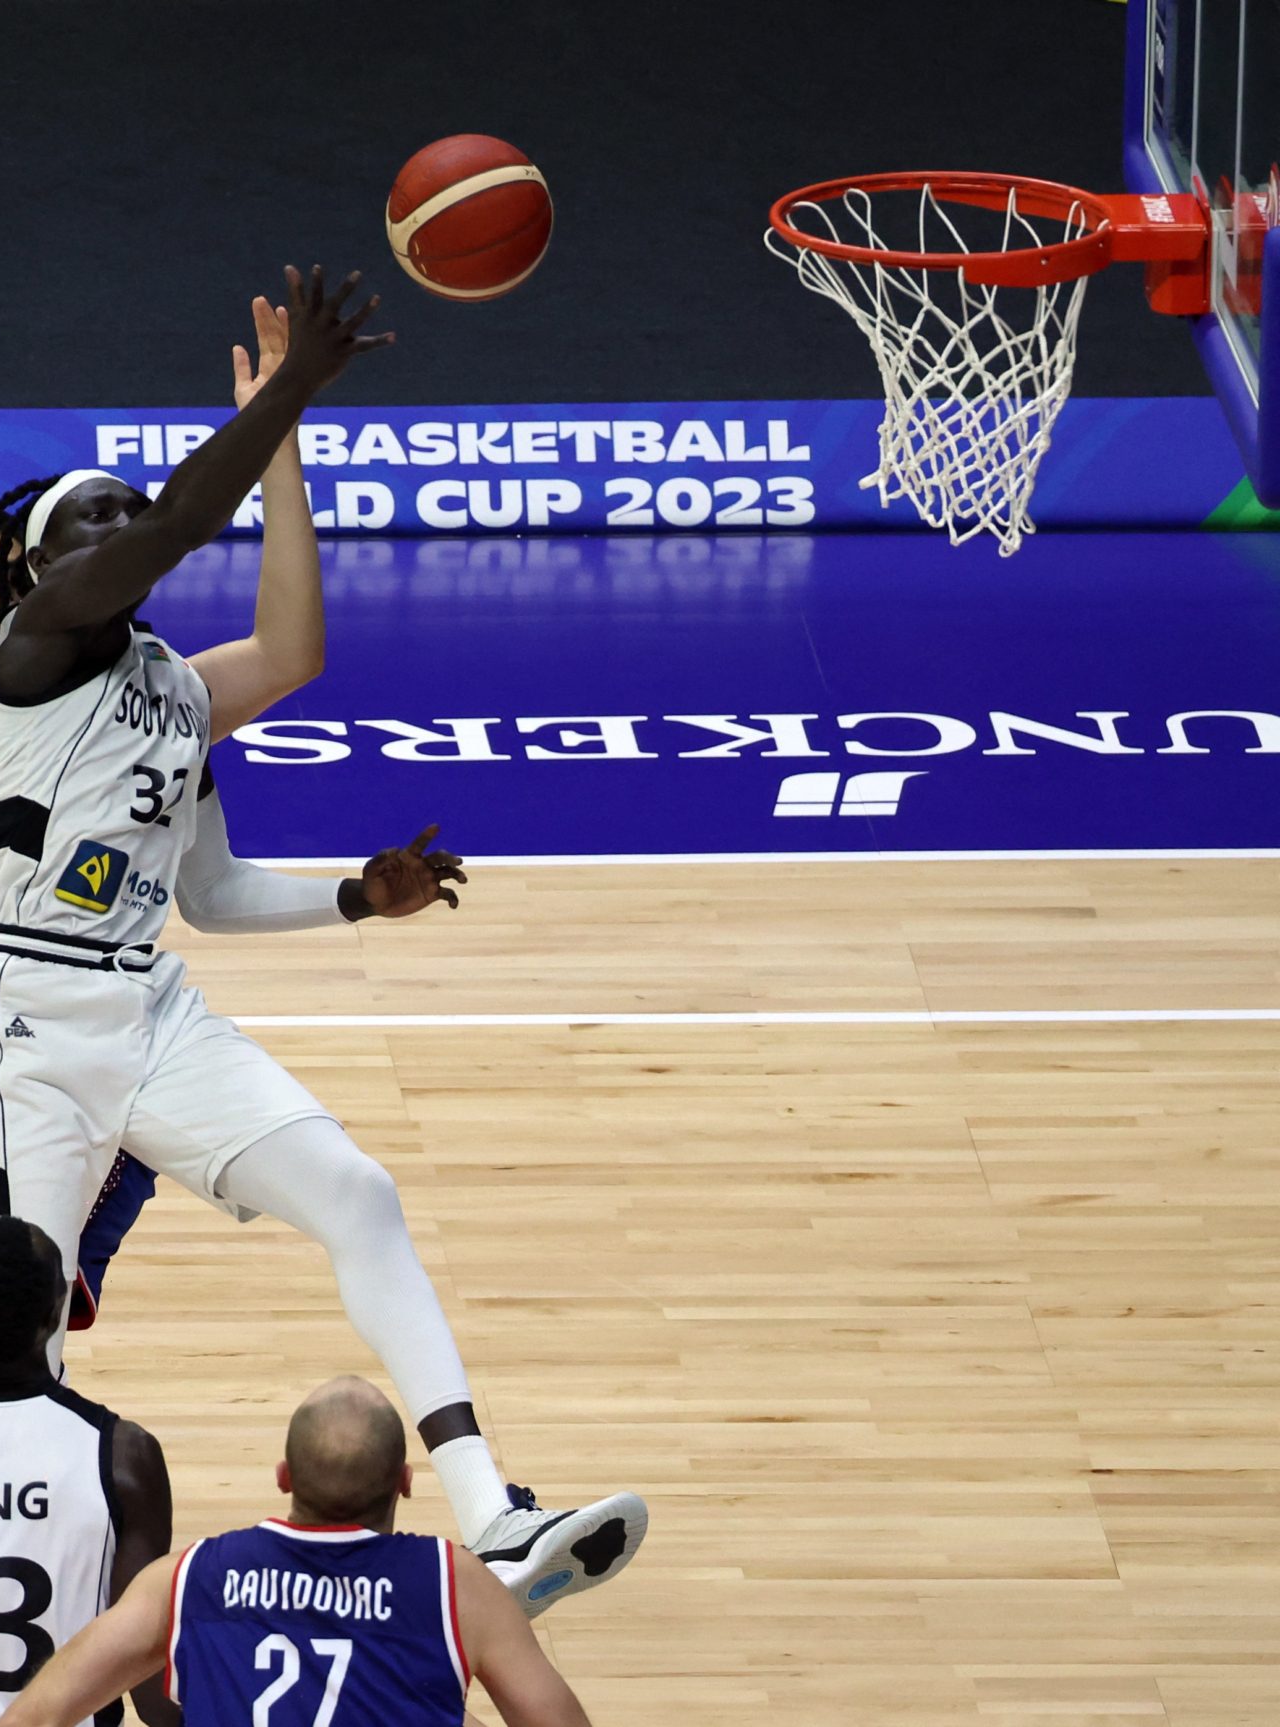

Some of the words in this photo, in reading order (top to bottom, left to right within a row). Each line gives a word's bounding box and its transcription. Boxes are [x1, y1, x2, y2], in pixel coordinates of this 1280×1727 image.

[96, 424, 217, 466] FIB
[297, 420, 811, 466] BASKETBALL
[416, 478, 582, 529] CUP
[604, 476, 816, 527] 2023
[130, 764, 189, 827] 32
[5, 1027, 36, 1038] PEAK
[223, 1567, 393, 1621] DAVIDOVAC
[253, 1633, 353, 1727] 27
